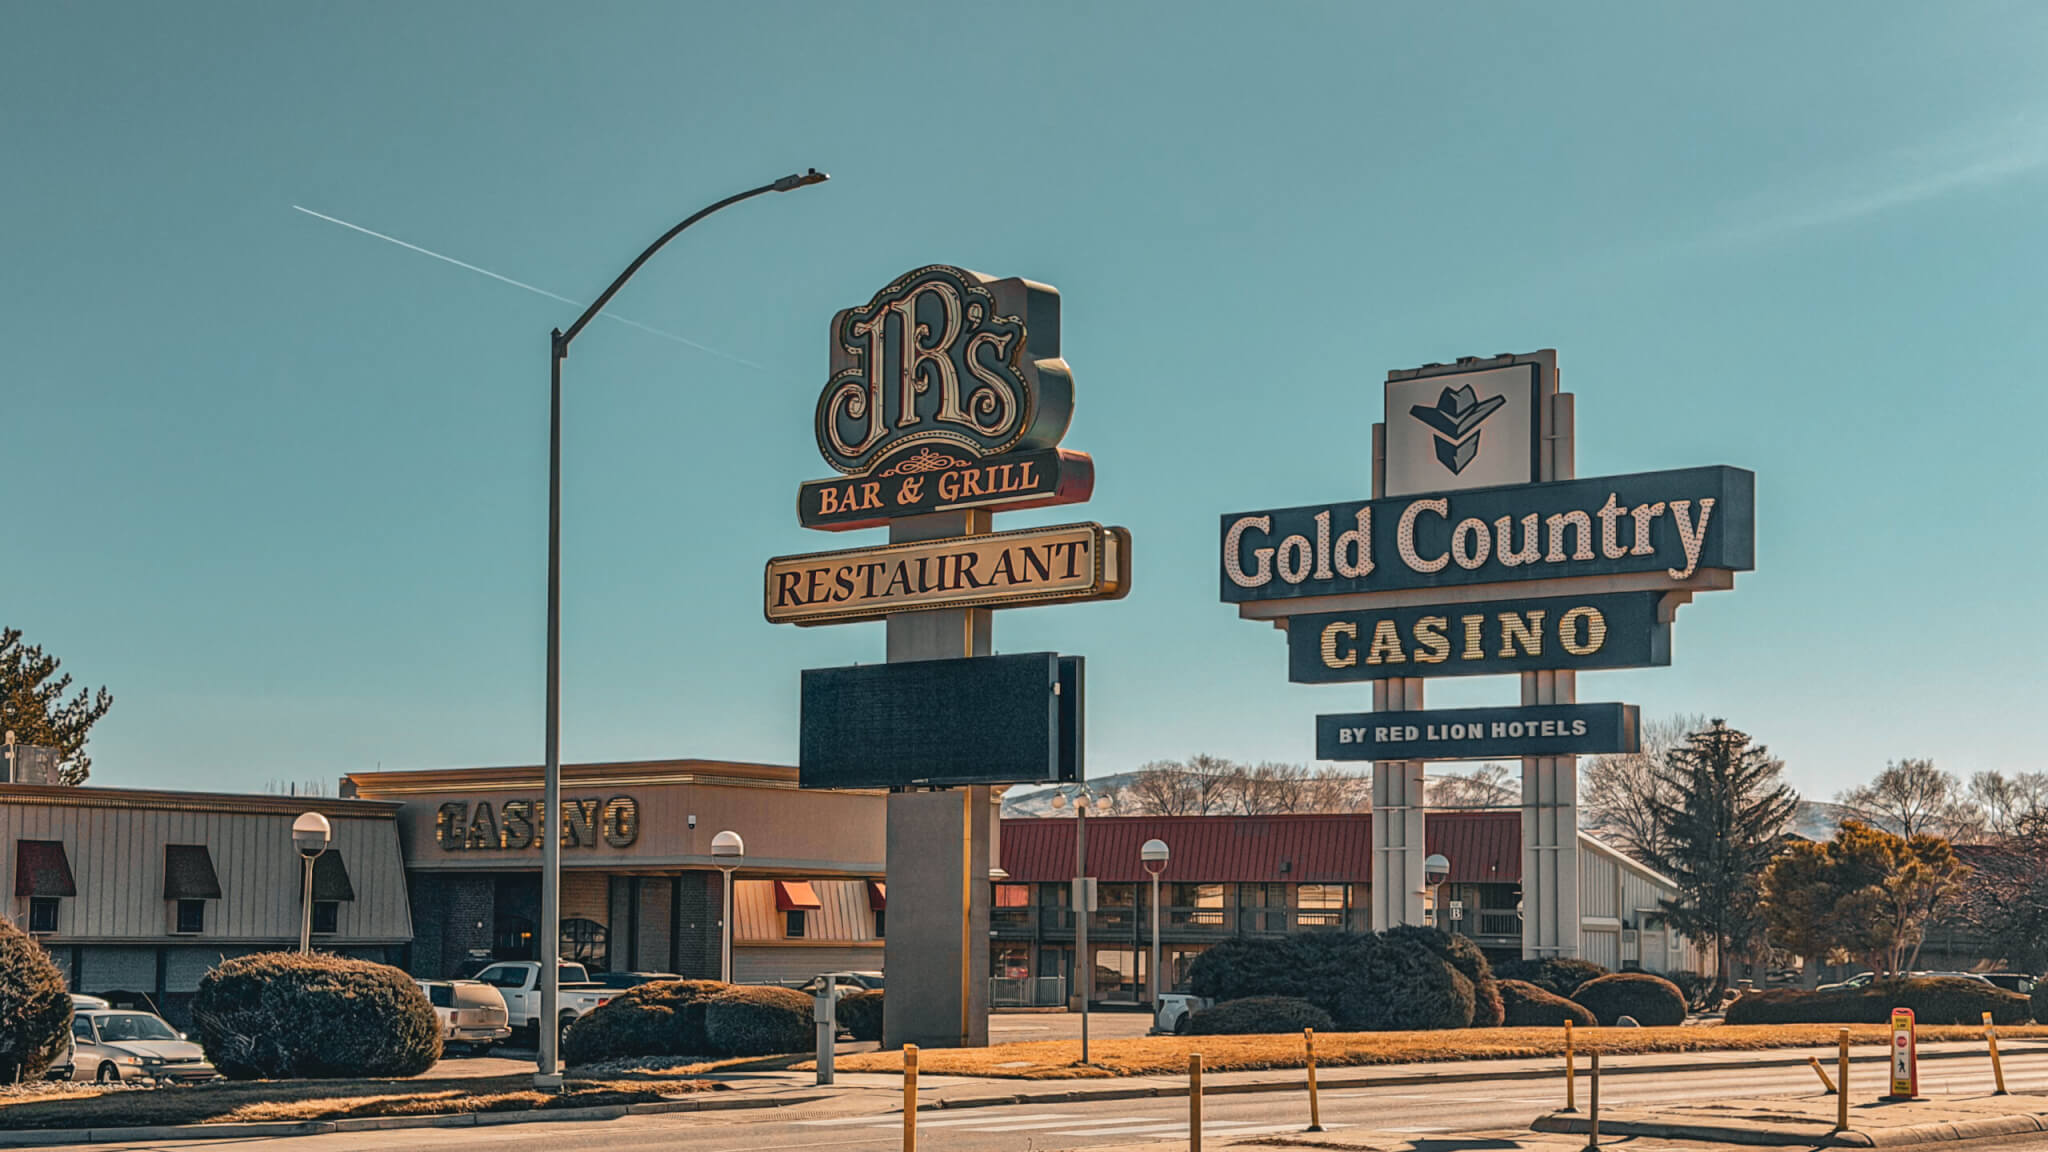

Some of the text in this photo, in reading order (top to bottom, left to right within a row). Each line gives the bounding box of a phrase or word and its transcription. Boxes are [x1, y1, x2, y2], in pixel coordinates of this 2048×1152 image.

[818, 461, 1040, 515] BAR & GRILL
[1224, 492, 1715, 588] Gold Country
[773, 540, 1088, 607] RESTAURANT
[1320, 606, 1607, 669] CASINO
[1339, 719, 1587, 744] BY RED LION HOTELS
